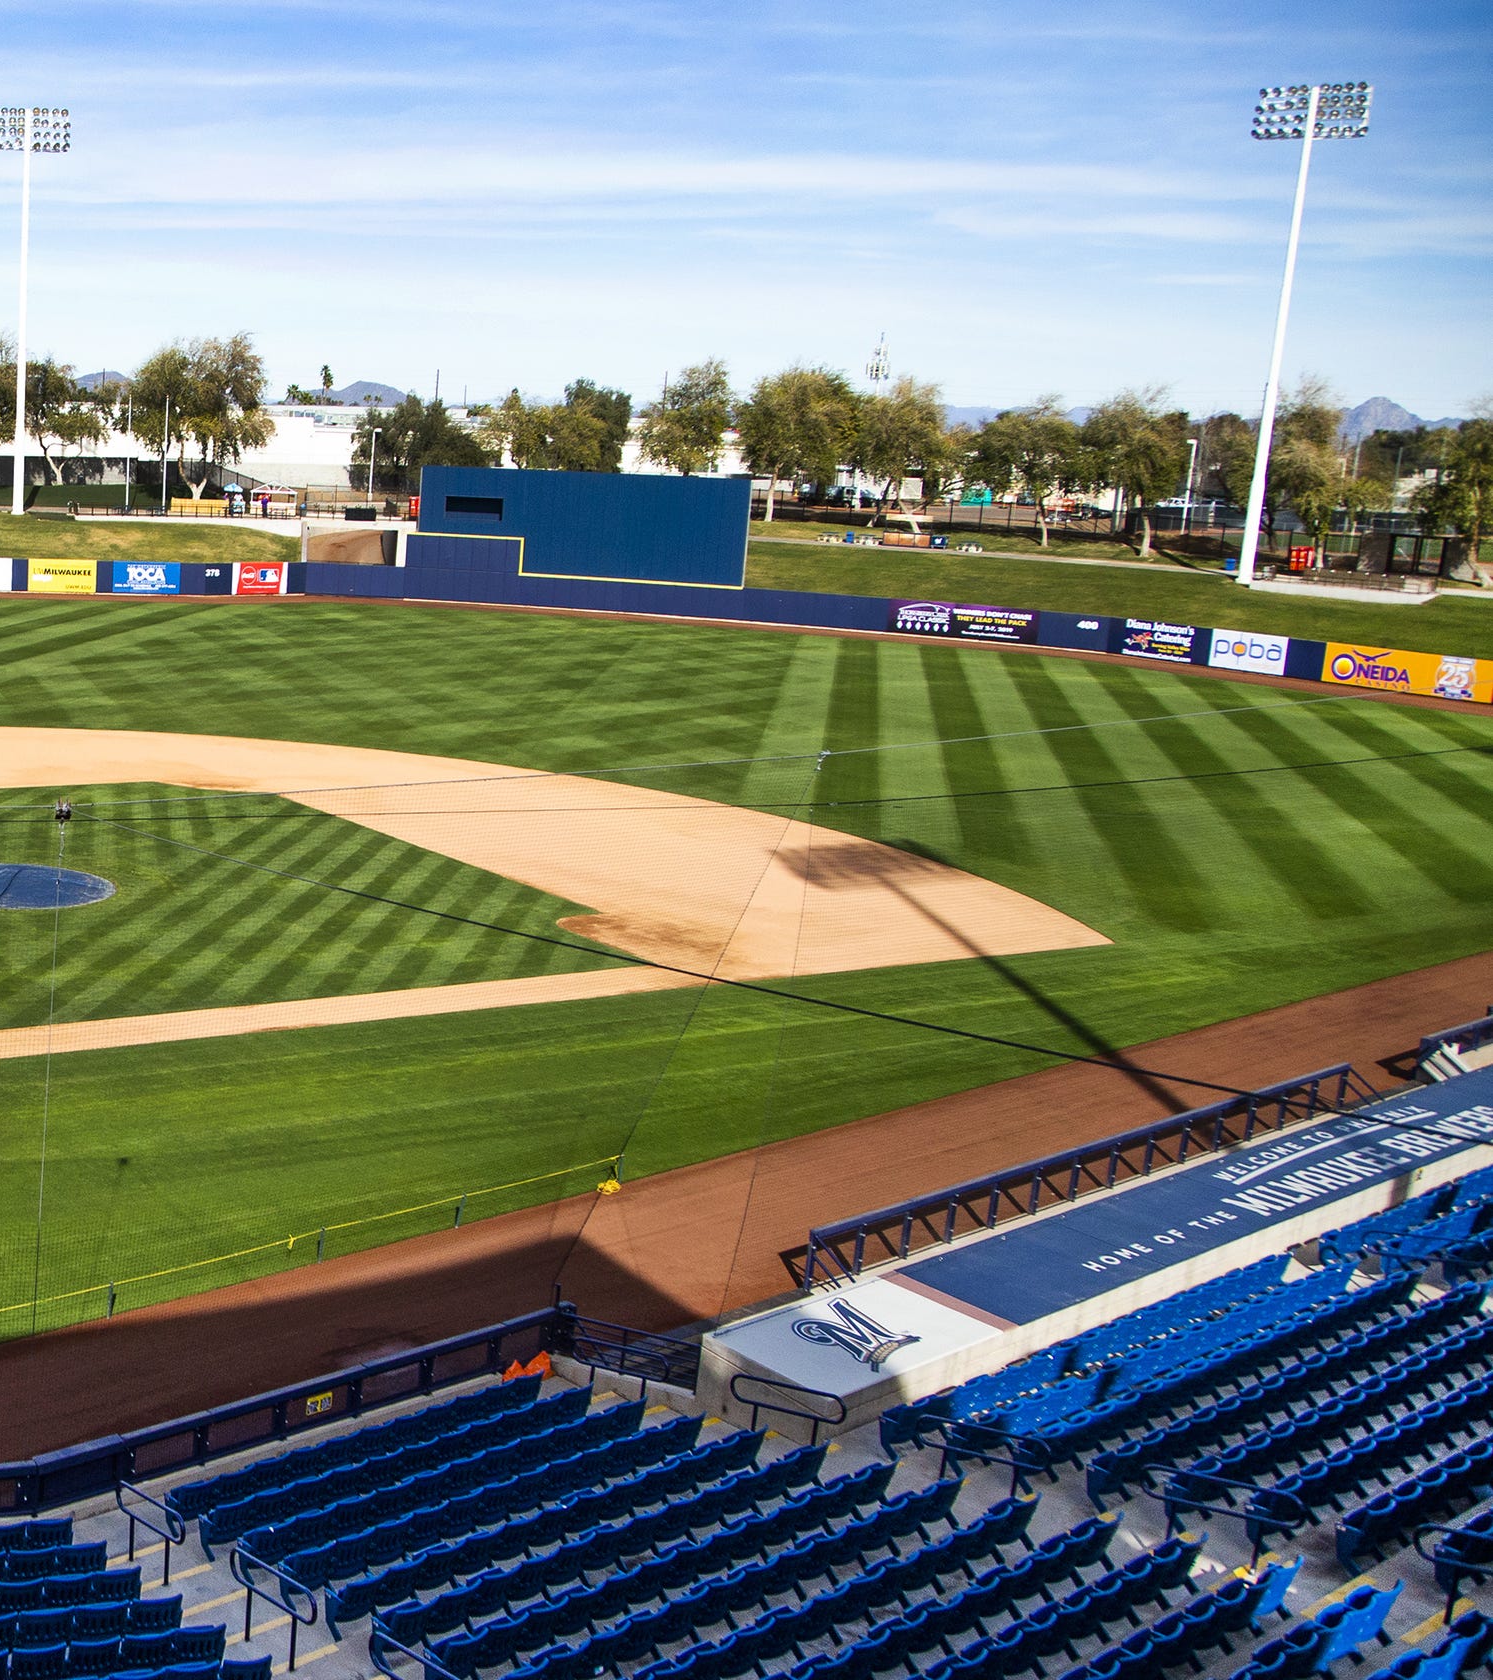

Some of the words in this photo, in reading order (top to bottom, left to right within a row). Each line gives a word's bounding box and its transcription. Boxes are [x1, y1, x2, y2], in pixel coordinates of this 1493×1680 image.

[127, 568, 166, 581] TOCA
[1076, 620, 1100, 630] 400
[1126, 618, 1152, 631] Diana
[1152, 622, 1195, 636] Johnson's
[1154, 631, 1192, 647] Catering
[1213, 637, 1283, 662] poba
[1331, 653, 1410, 684] ONEIDA
[1438, 664, 1472, 688] 25
[1212, 1140, 1305, 1182] WELCOME
[1303, 1131, 1335, 1144] TO
[1081, 1242, 1154, 1273] HOME
[1157, 1228, 1187, 1246] OF
[1188, 1209, 1238, 1230] THE
[1220, 1146, 1413, 1217] MILWAUKEE
